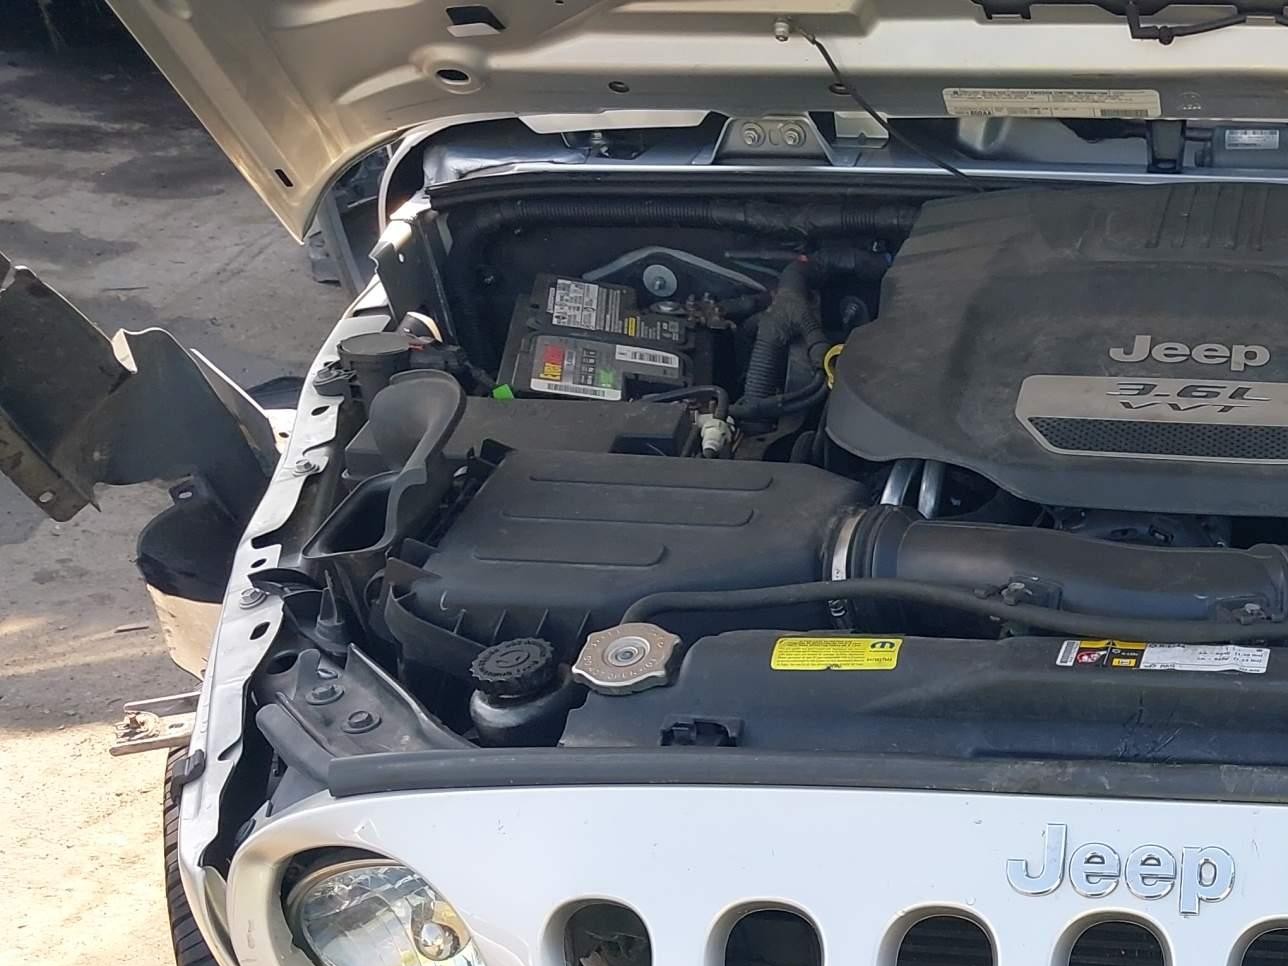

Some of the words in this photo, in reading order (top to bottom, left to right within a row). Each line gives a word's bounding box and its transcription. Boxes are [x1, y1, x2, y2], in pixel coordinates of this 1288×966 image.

[1109, 335, 1270, 371] Jeep
[1106, 382, 1272, 401] 3.6L
[1119, 400, 1251, 413] VVT
[1006, 823, 1236, 915] Jeep
